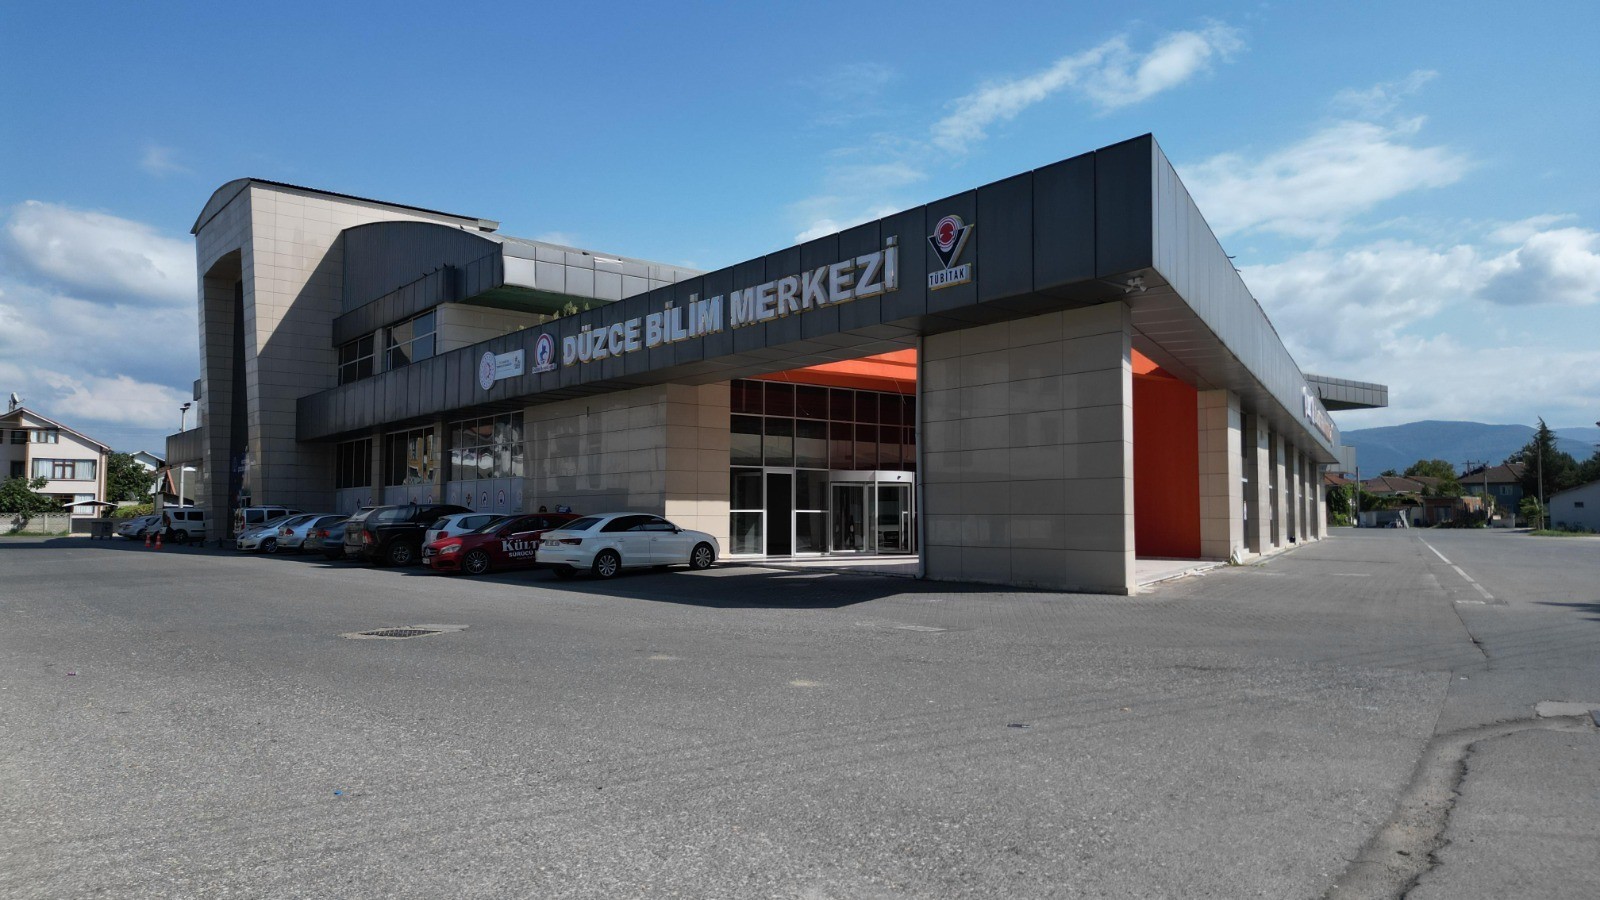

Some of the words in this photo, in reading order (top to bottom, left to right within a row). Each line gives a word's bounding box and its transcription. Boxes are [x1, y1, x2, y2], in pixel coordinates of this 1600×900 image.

[929, 268, 965, 286] TÜBİTAK
[563, 318, 642, 366] DÜZCE
[646, 293, 723, 348] BİLİM
[730, 235, 899, 329] MERKEZİ
[502, 539, 539, 552] KÜLT
